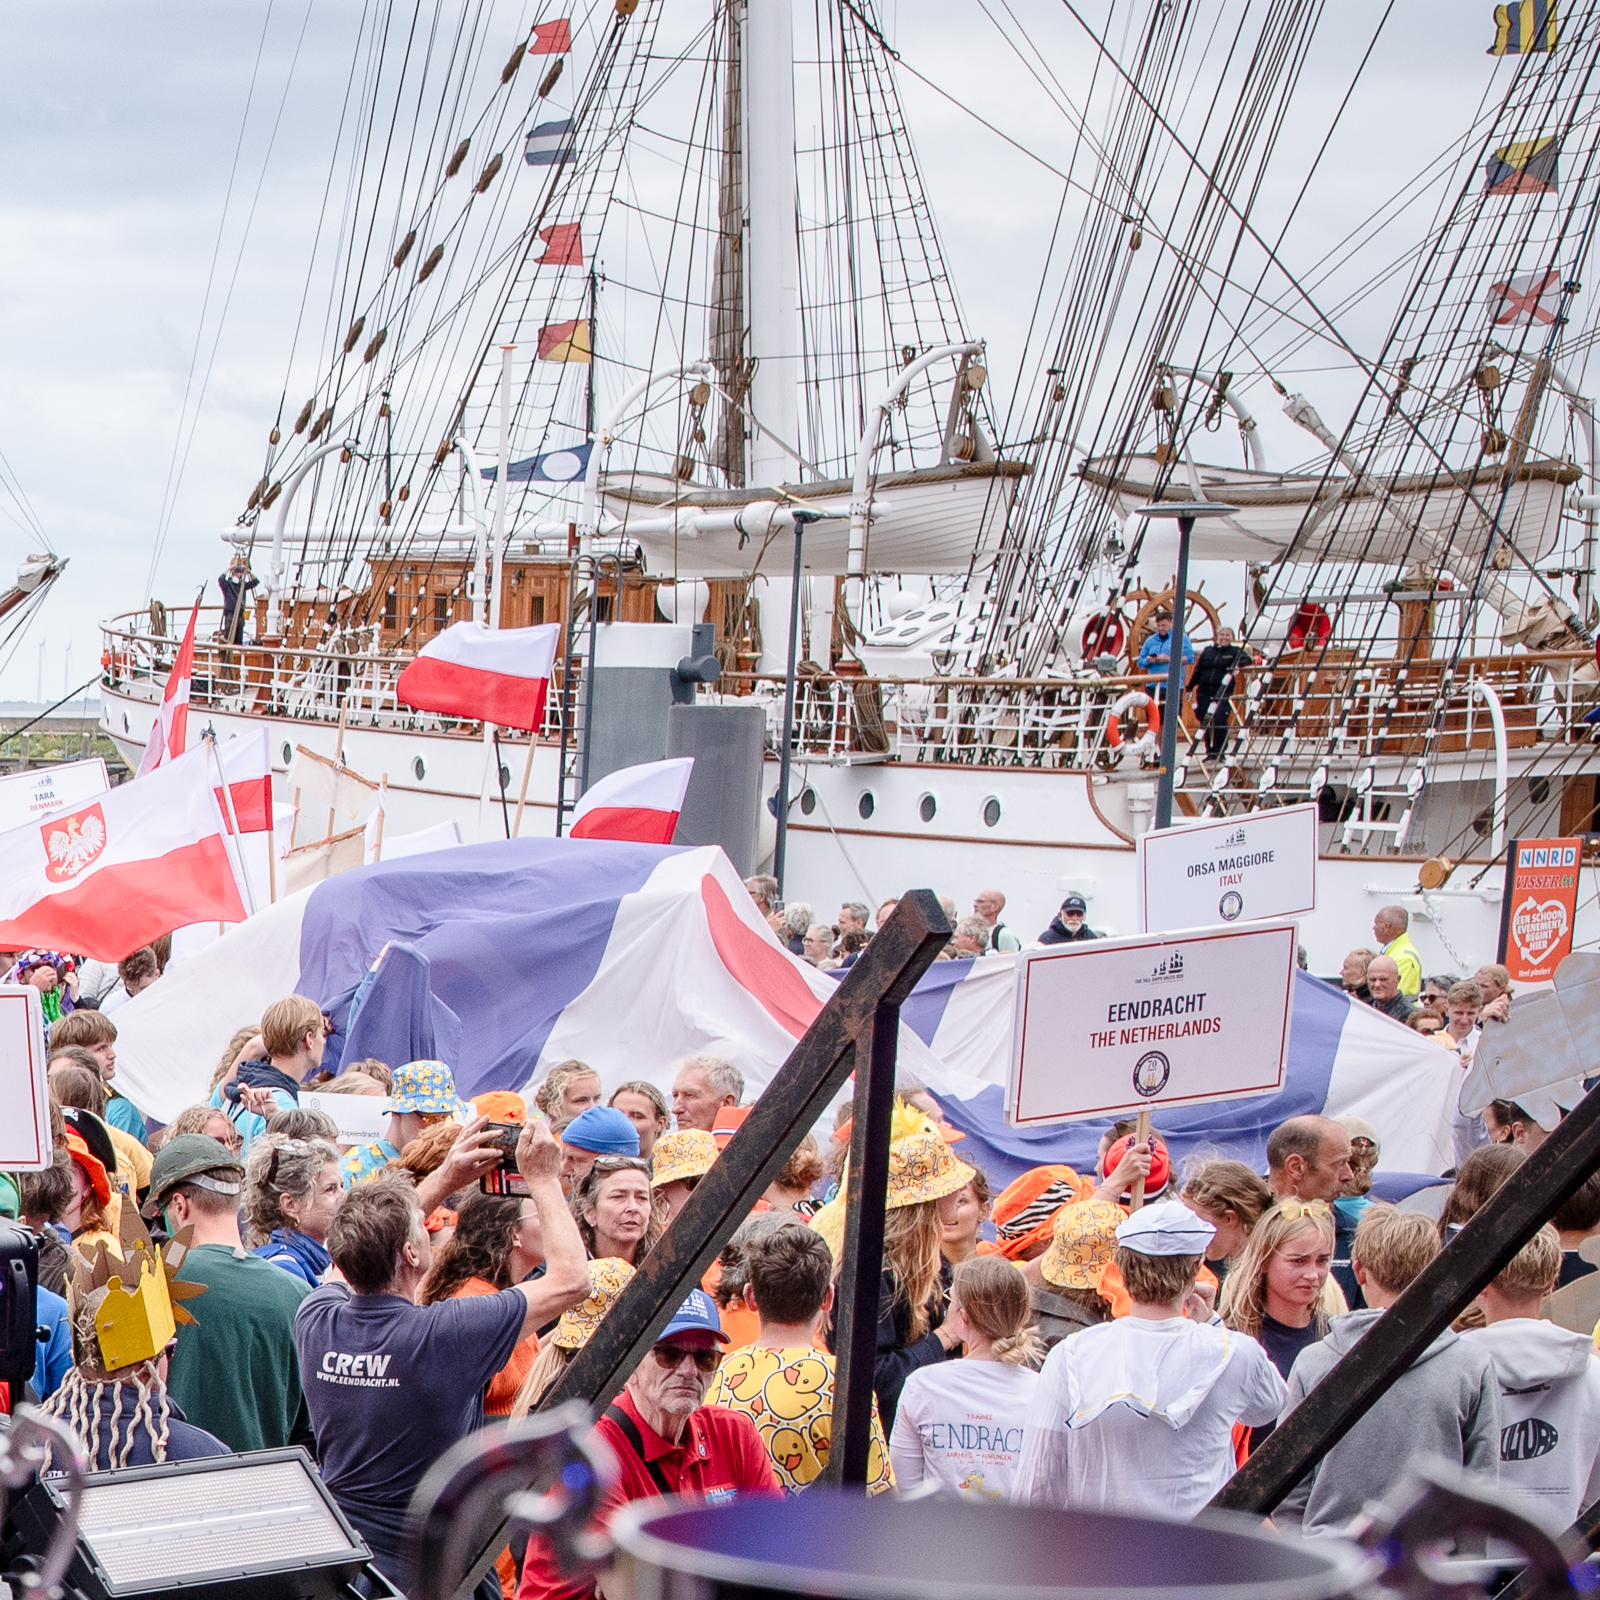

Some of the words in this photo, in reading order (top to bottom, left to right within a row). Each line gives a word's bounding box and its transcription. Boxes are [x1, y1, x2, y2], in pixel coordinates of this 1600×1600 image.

[34, 790, 56, 802] TARA
[29, 799, 64, 813] DENMARK
[1187, 861, 1216, 878] ORSA
[1218, 850, 1275, 872] MAGGIORE
[1520, 849, 1575, 866] NNRD
[1219, 873, 1243, 888] ITALY
[1529, 940, 1548, 951] HIER
[1107, 992, 1207, 1023] EENDRACHT
[1090, 1030, 1116, 1049] THE
[1120, 1017, 1221, 1045] NETHERLANDS
[338, 1129, 380, 1139] chipeendracht
[322, 1351, 392, 1378] CREW
[316, 1370, 400, 1389] WWW.EENDRACHT.NL
[918, 1423, 1024, 1453] EENDRAC
